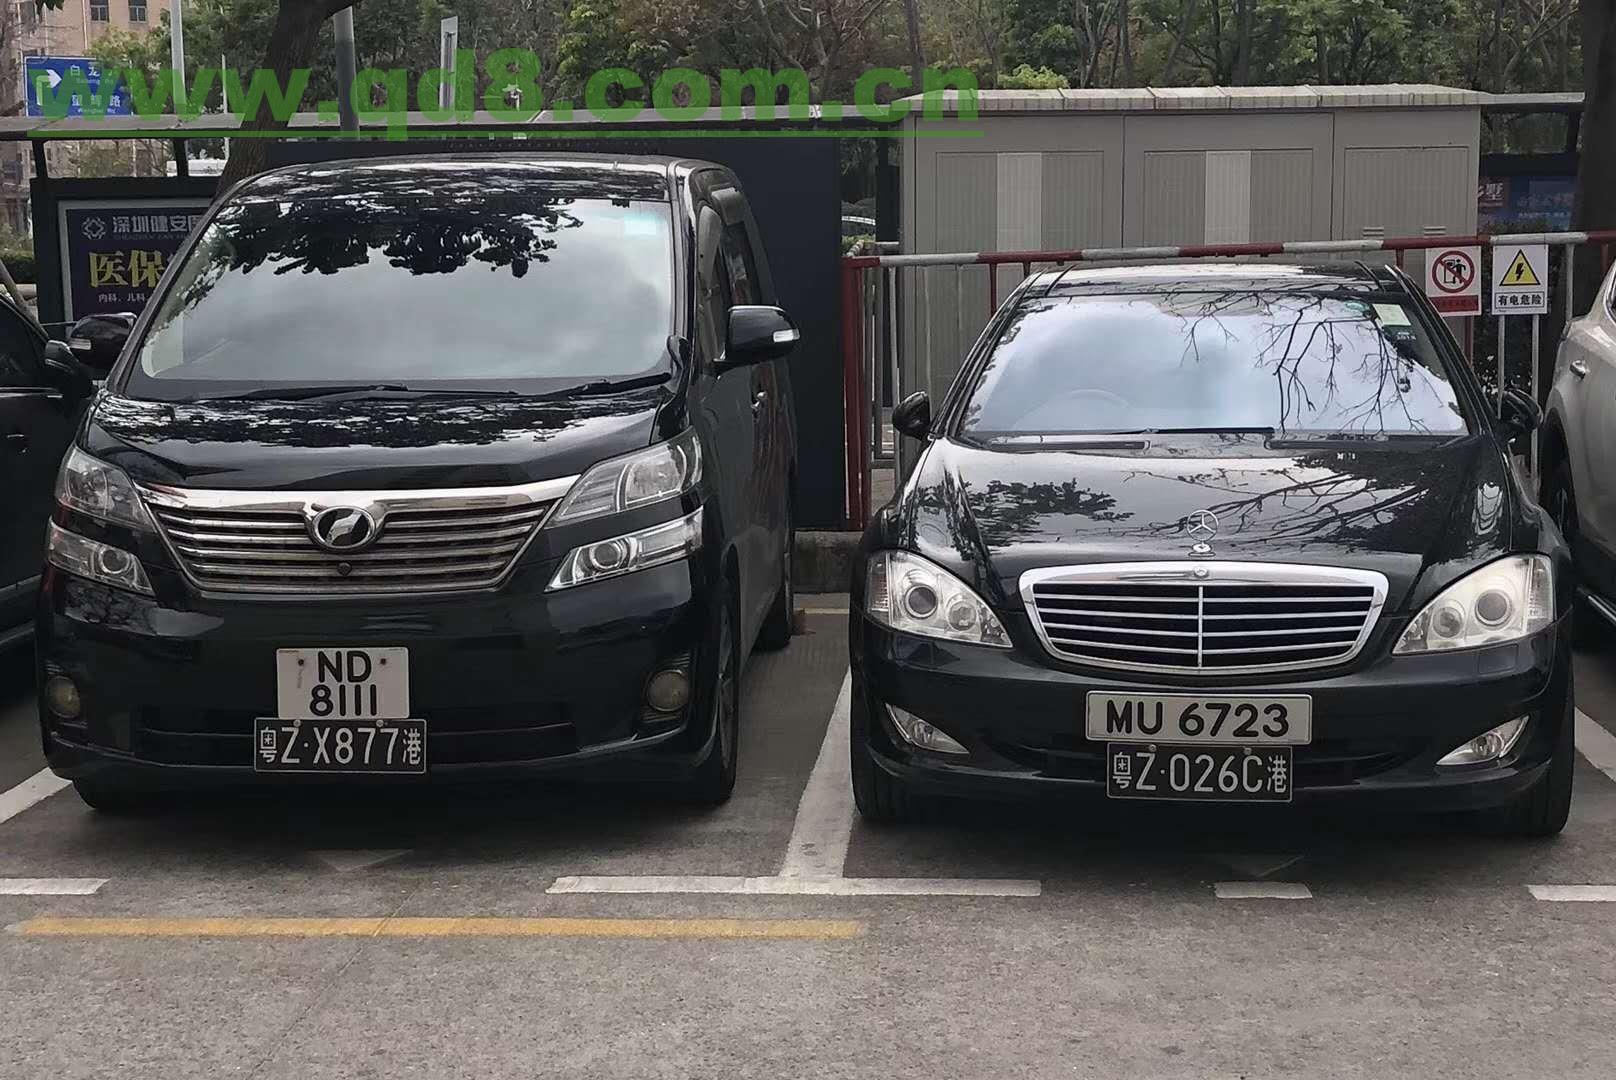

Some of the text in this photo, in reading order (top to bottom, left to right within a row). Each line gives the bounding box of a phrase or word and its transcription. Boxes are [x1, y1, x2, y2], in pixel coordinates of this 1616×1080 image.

[1498, 294, 1542, 306] 有电危险
[317, 650, 372, 683] ND
[309, 684, 377, 716] 8111
[1106, 700, 1289, 738] MU 6723
[259, 726, 422, 765] 粤Z·X877港
[1112, 752, 1287, 793] 粤Z·026C港
